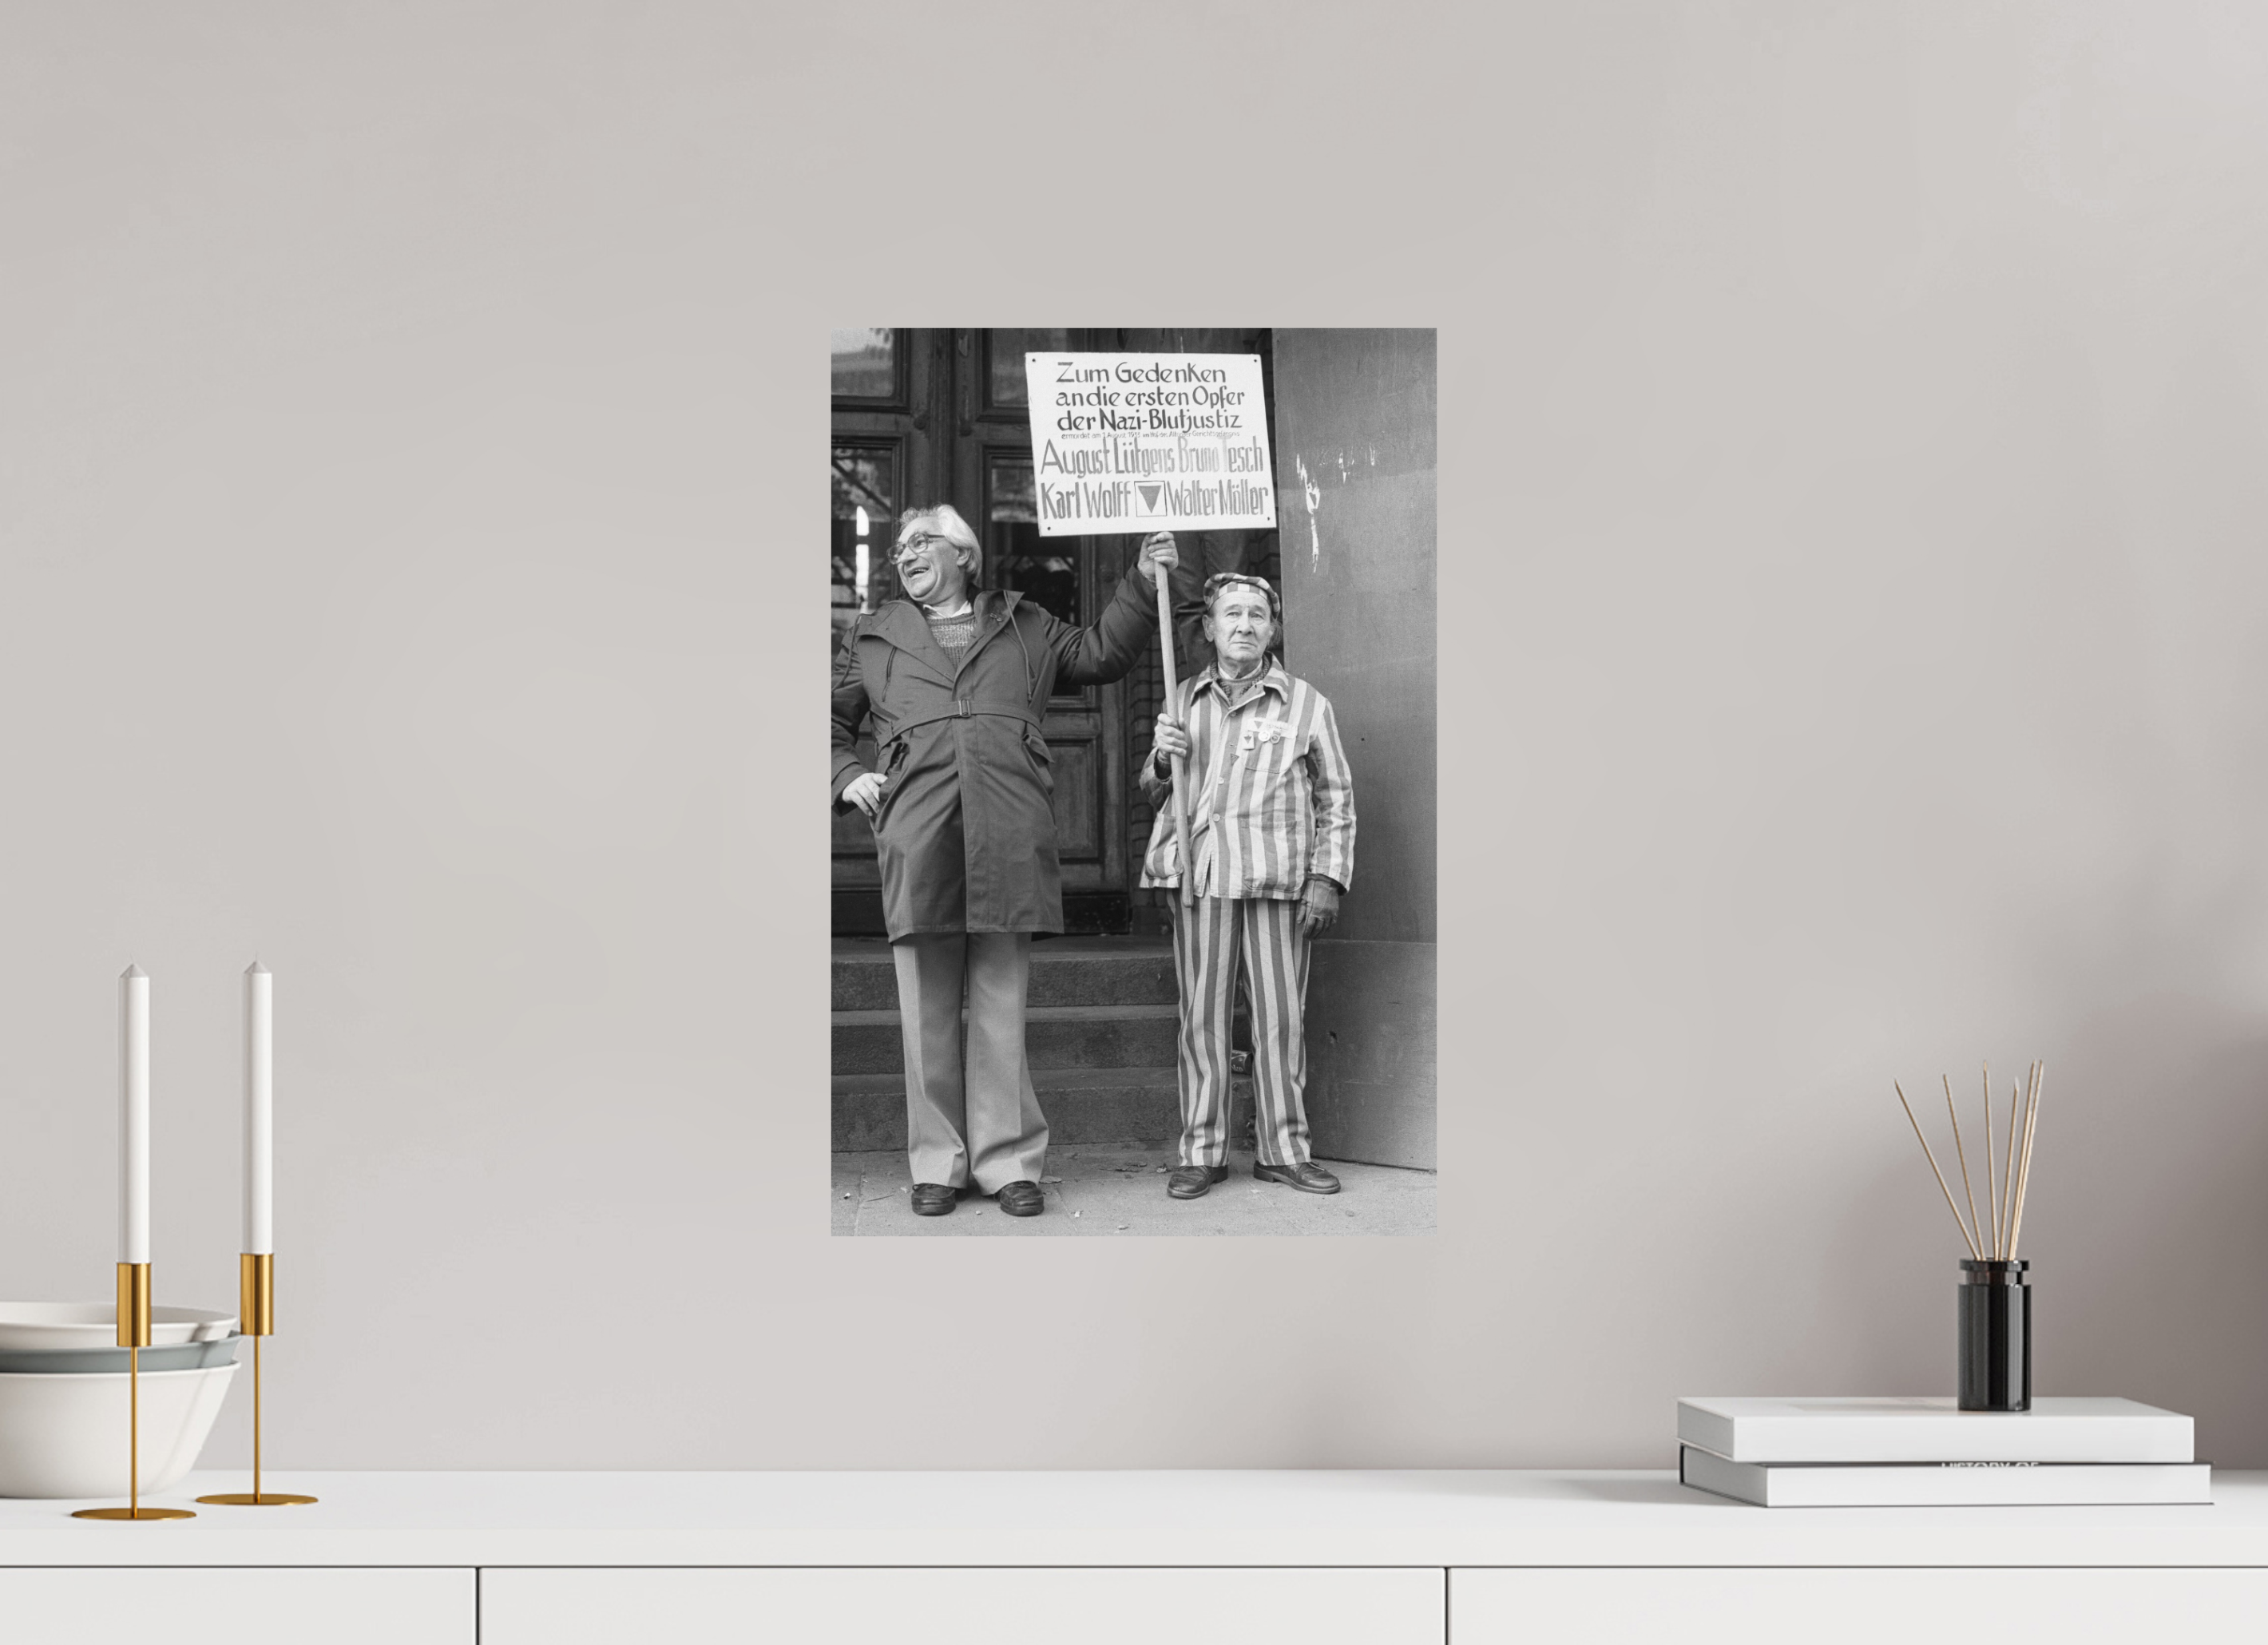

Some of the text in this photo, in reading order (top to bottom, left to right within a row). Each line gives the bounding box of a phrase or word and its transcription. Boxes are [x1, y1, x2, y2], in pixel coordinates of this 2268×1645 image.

[1056, 362, 1109, 383] Zum
[1124, 386, 1189, 406] ersten
[1192, 385, 1245, 409] Opfer
[1057, 408, 1243, 433] der Nazi-Blutjustiz
[1041, 435, 1263, 478] August Lütgens Bruno Tesch
[1041, 479, 1269, 519] Karl Wolff Walter Möller
